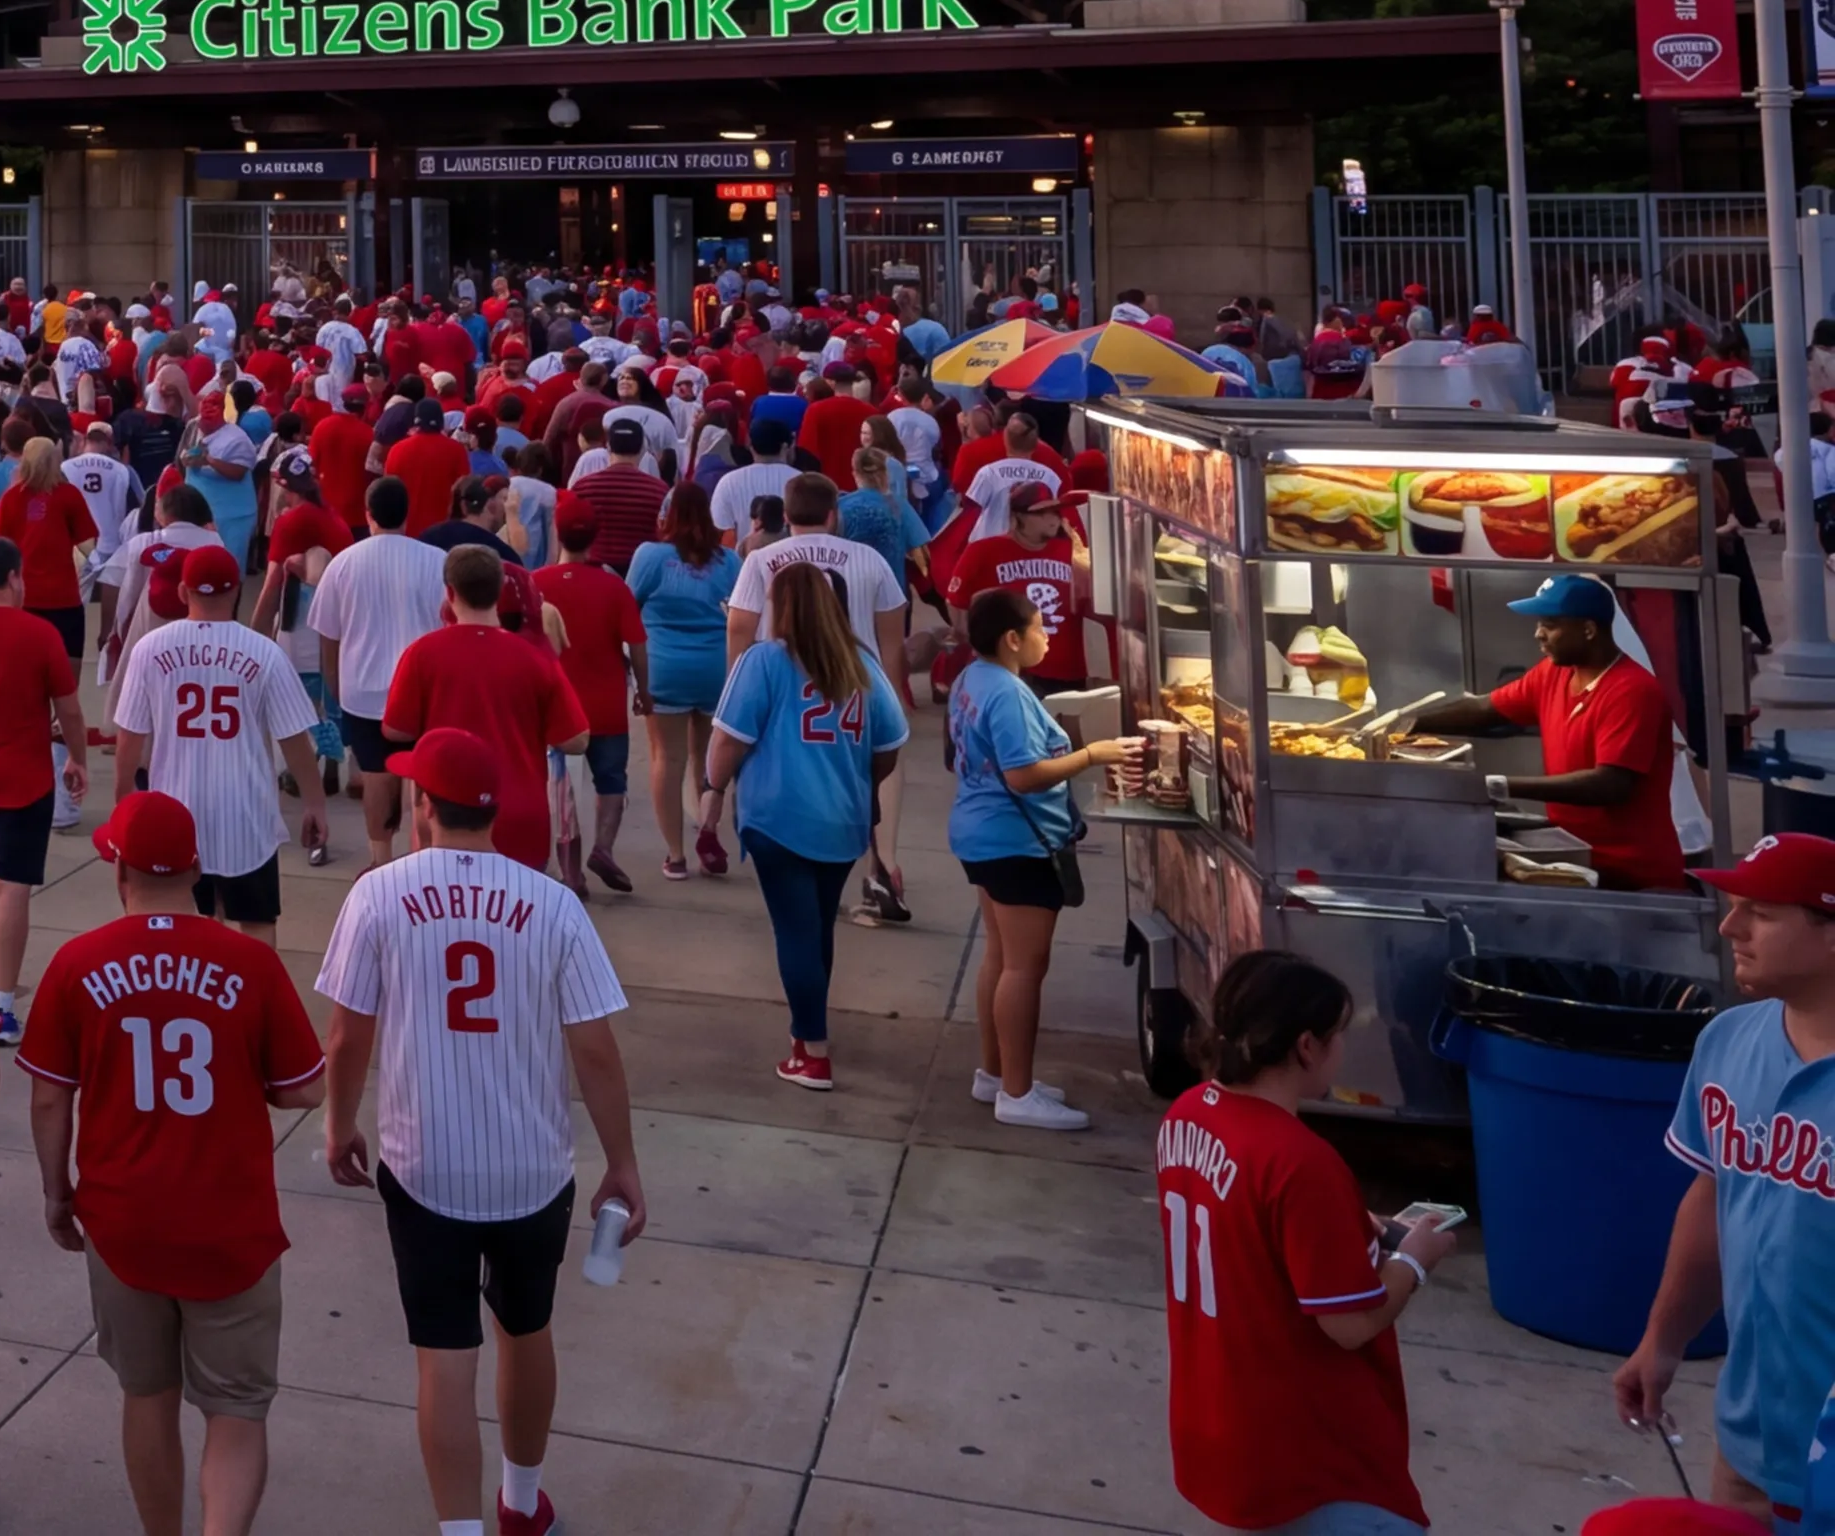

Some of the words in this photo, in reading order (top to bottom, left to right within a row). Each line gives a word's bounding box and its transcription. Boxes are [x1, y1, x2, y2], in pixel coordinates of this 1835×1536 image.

[176, 682, 241, 740] 25
[801, 680, 864, 744] 24
[445, 940, 499, 1033] 2
[121, 1017, 213, 1116] 13
